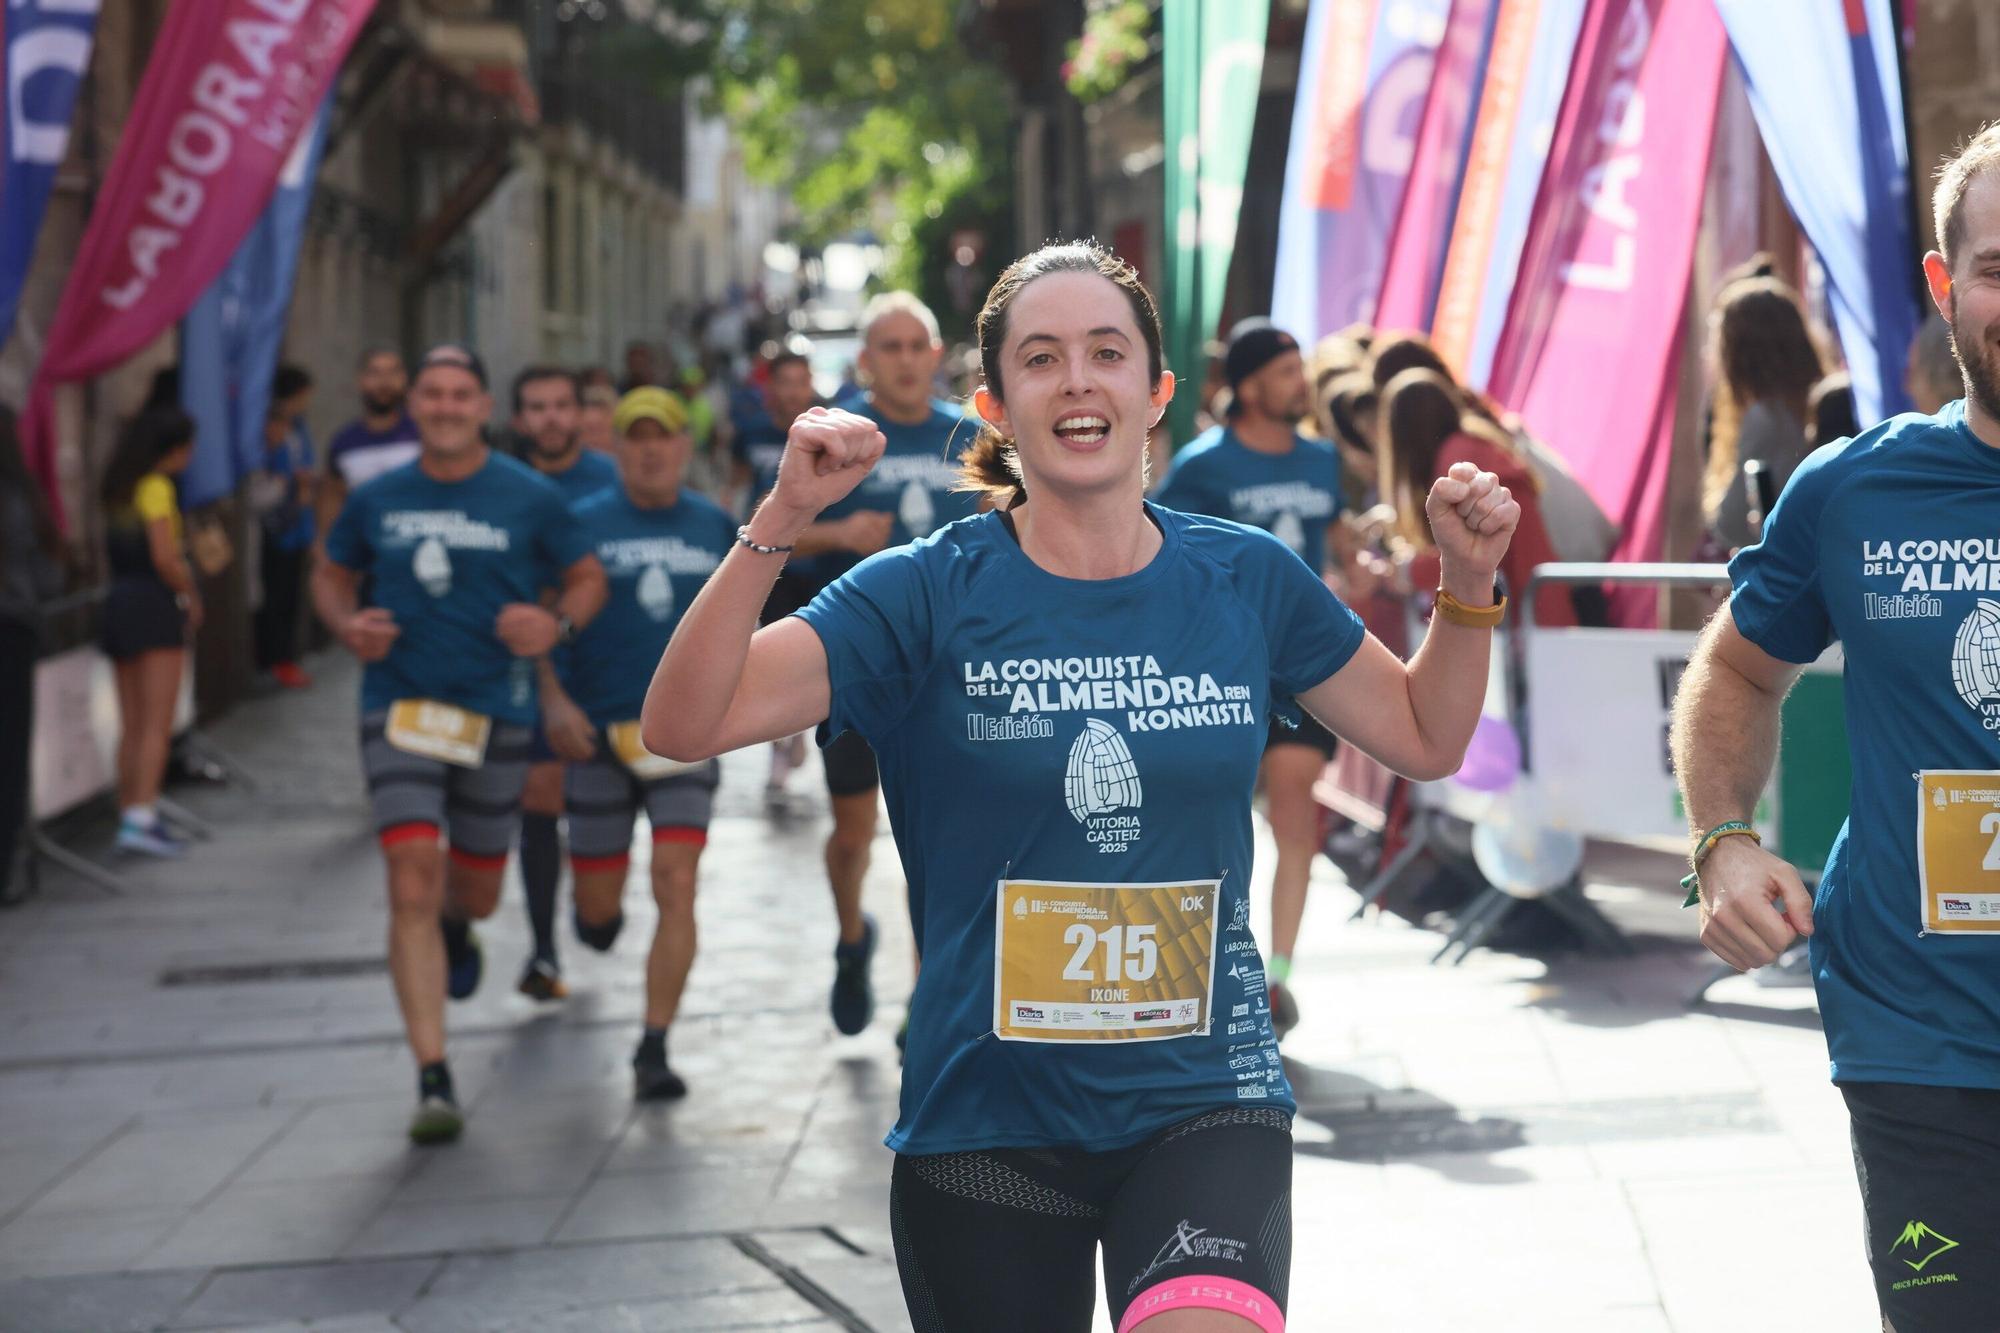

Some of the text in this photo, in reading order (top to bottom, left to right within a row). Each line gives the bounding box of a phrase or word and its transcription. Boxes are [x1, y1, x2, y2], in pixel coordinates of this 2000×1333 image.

[1863, 540, 1894, 561] LA
[1863, 563, 1883, 576] DE
[1885, 562, 1905, 575] LA
[1864, 593, 1942, 620] II Edición
[965, 655, 1163, 683] LA CONQUISTA
[966, 673, 1251, 713] DE LA ALMENDRA REN
[967, 713, 1054, 740] II Edición
[1127, 703, 1255, 733] KONKISTA
[1086, 815, 1141, 830] VITORIA
[1086, 829, 1141, 843] GASTEIZ
[1098, 842, 1128, 854] 2025
[1052, 906, 1098, 914] ALMENDRA
[1062, 922, 1158, 982] 215
[1224, 940, 1257, 954] LABORAL
[1090, 987, 1131, 1002] IXONE
[1143, 1285, 1262, 1315] DE ISLA
